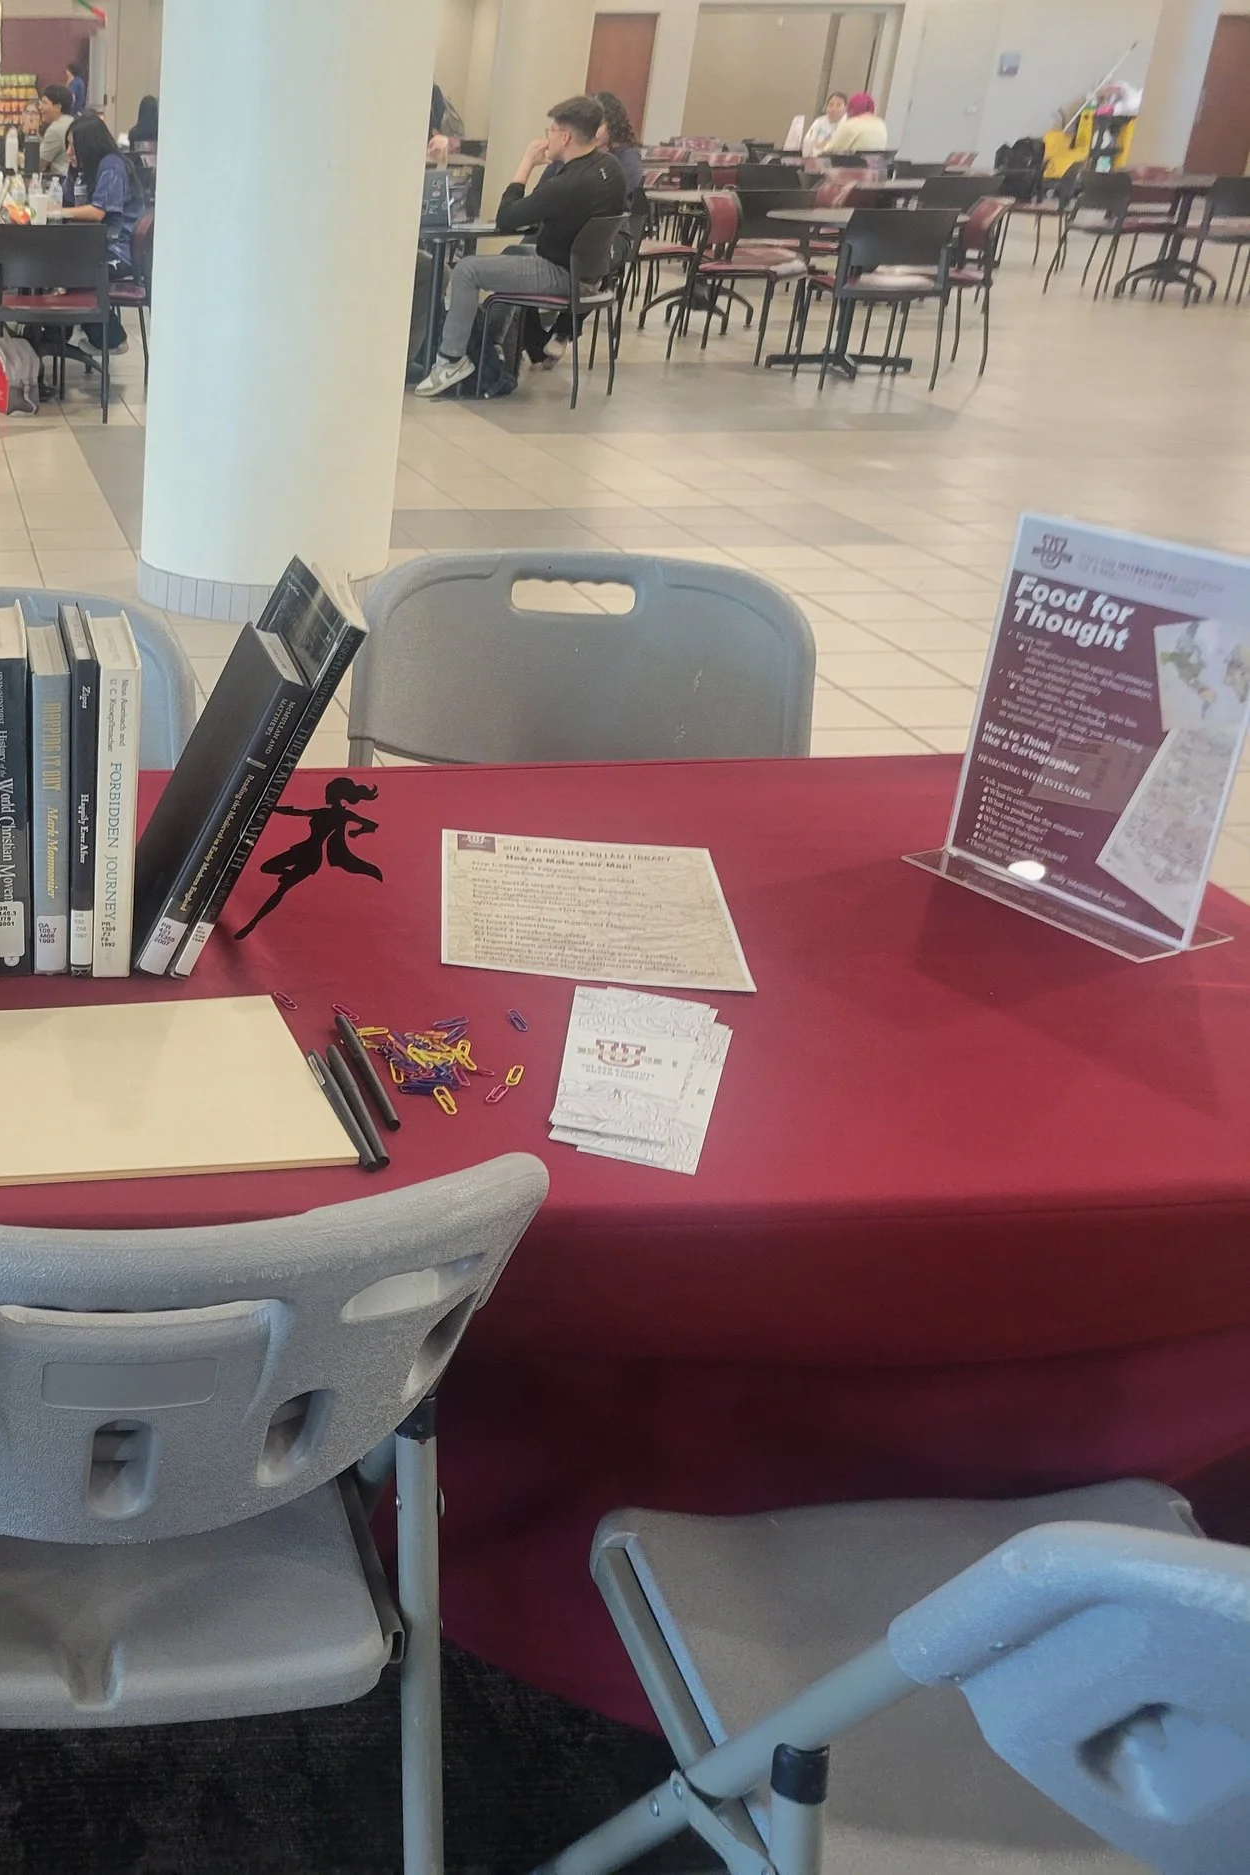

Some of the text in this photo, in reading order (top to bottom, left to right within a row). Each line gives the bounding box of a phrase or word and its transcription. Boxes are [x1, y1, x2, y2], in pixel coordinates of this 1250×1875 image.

[1014, 575, 1088, 613] Food
[1092, 593, 1136, 624] for
[1014, 599, 1130, 652] Thought
[265, 701, 296, 755] McMULLAN AND
[266, 698, 288, 736] MATTHEWS
[294, 726, 310, 752] THE
[984, 720, 1051, 752] How to Think
[982, 732, 1080, 775] like a Cartographer
[78, 686, 90, 864] Zipes Happily Ever After
[234, 773, 255, 802] Reading
[264, 749, 301, 810] POWER
[984, 776, 1024, 796] Ask yourself:
[42, 702, 62, 899] MAPPING IT OUT Mark Monmonier
[107, 762, 122, 848] FORBIDDEN
[230, 798, 242, 811] the
[986, 805, 1000, 817] Who
[1000, 812, 1025, 828] controls
[216, 808, 238, 840] Medieval
[988, 796, 1084, 840] What is pushed to the margins?
[204, 844, 219, 864] Early
[506, 854, 528, 862] How
[546, 858, 576, 866] Make
[606, 862, 632, 870] Map!
[192, 861, 210, 888] Modern
[180, 885, 198, 912] England
